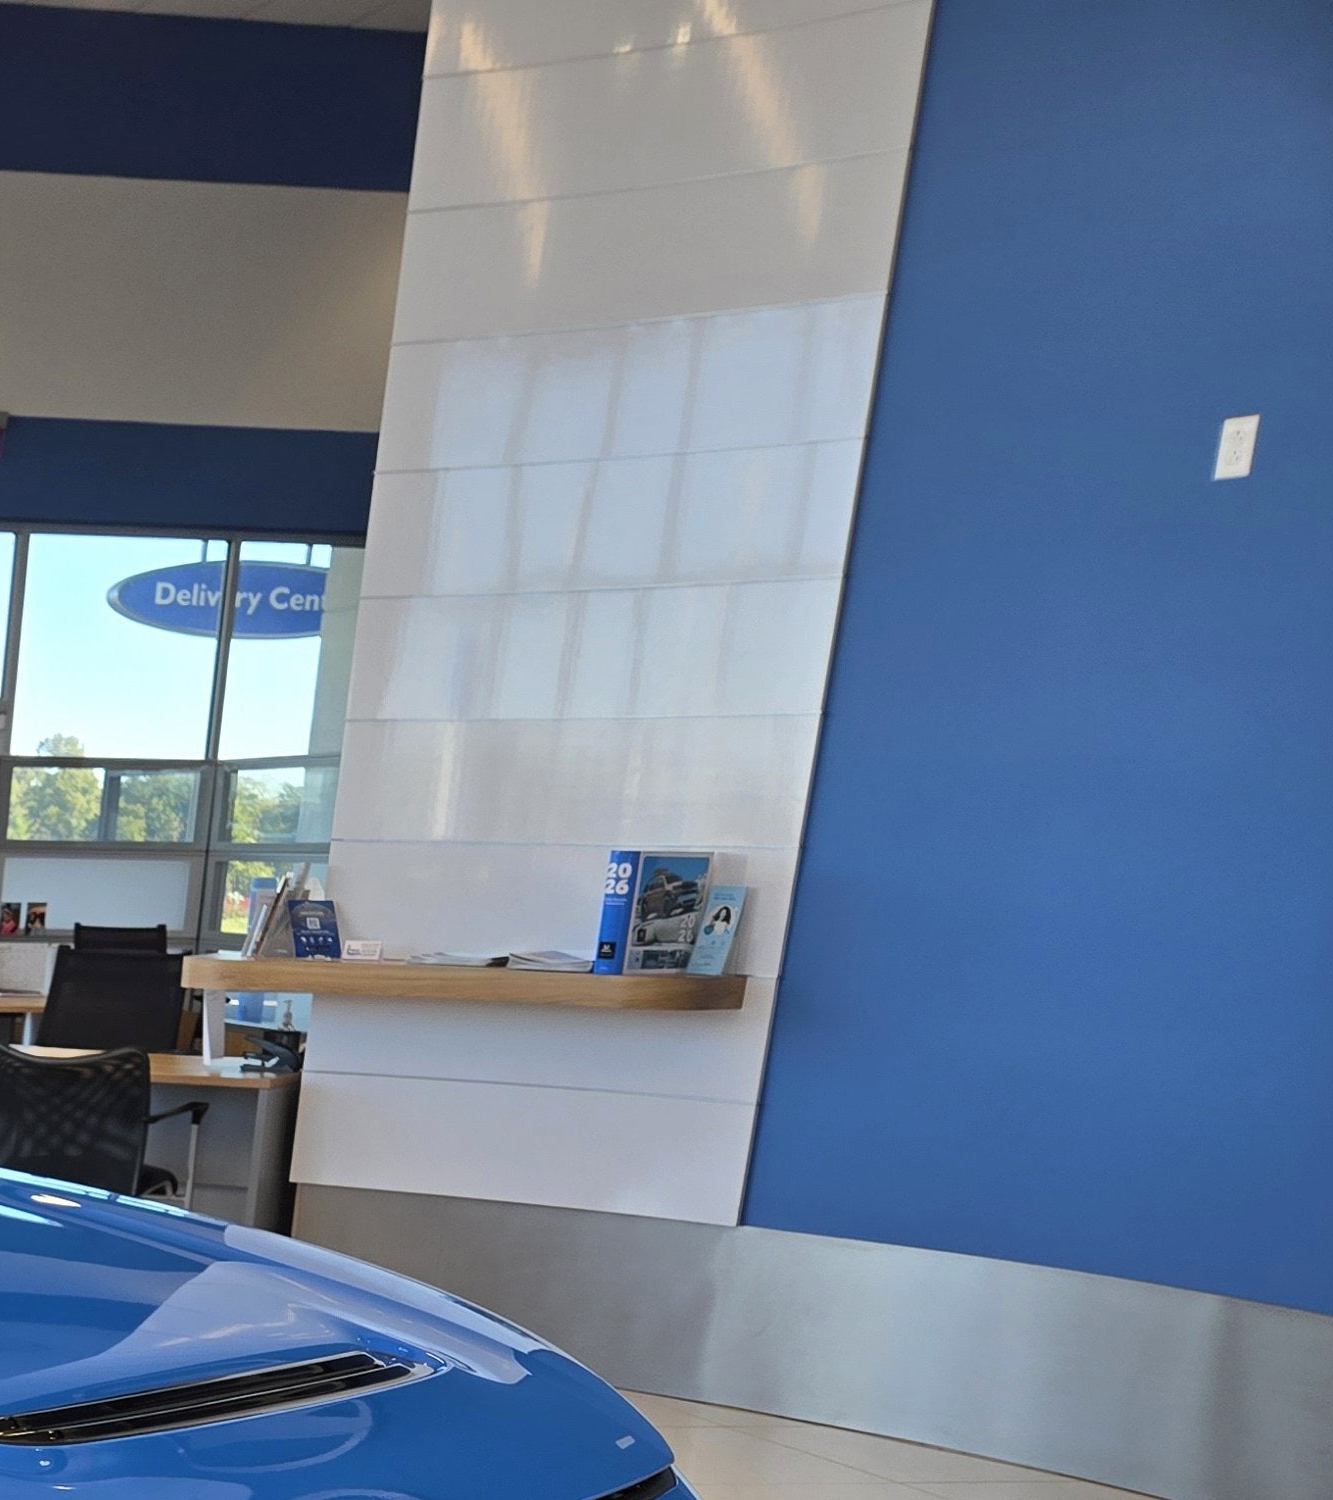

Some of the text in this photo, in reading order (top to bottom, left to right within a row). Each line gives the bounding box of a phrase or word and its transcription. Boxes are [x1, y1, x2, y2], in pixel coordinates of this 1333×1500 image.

[154, 581, 325, 615] Delivry Cen
[606, 862, 633, 878] 20
[604, 879, 630, 895] 26
